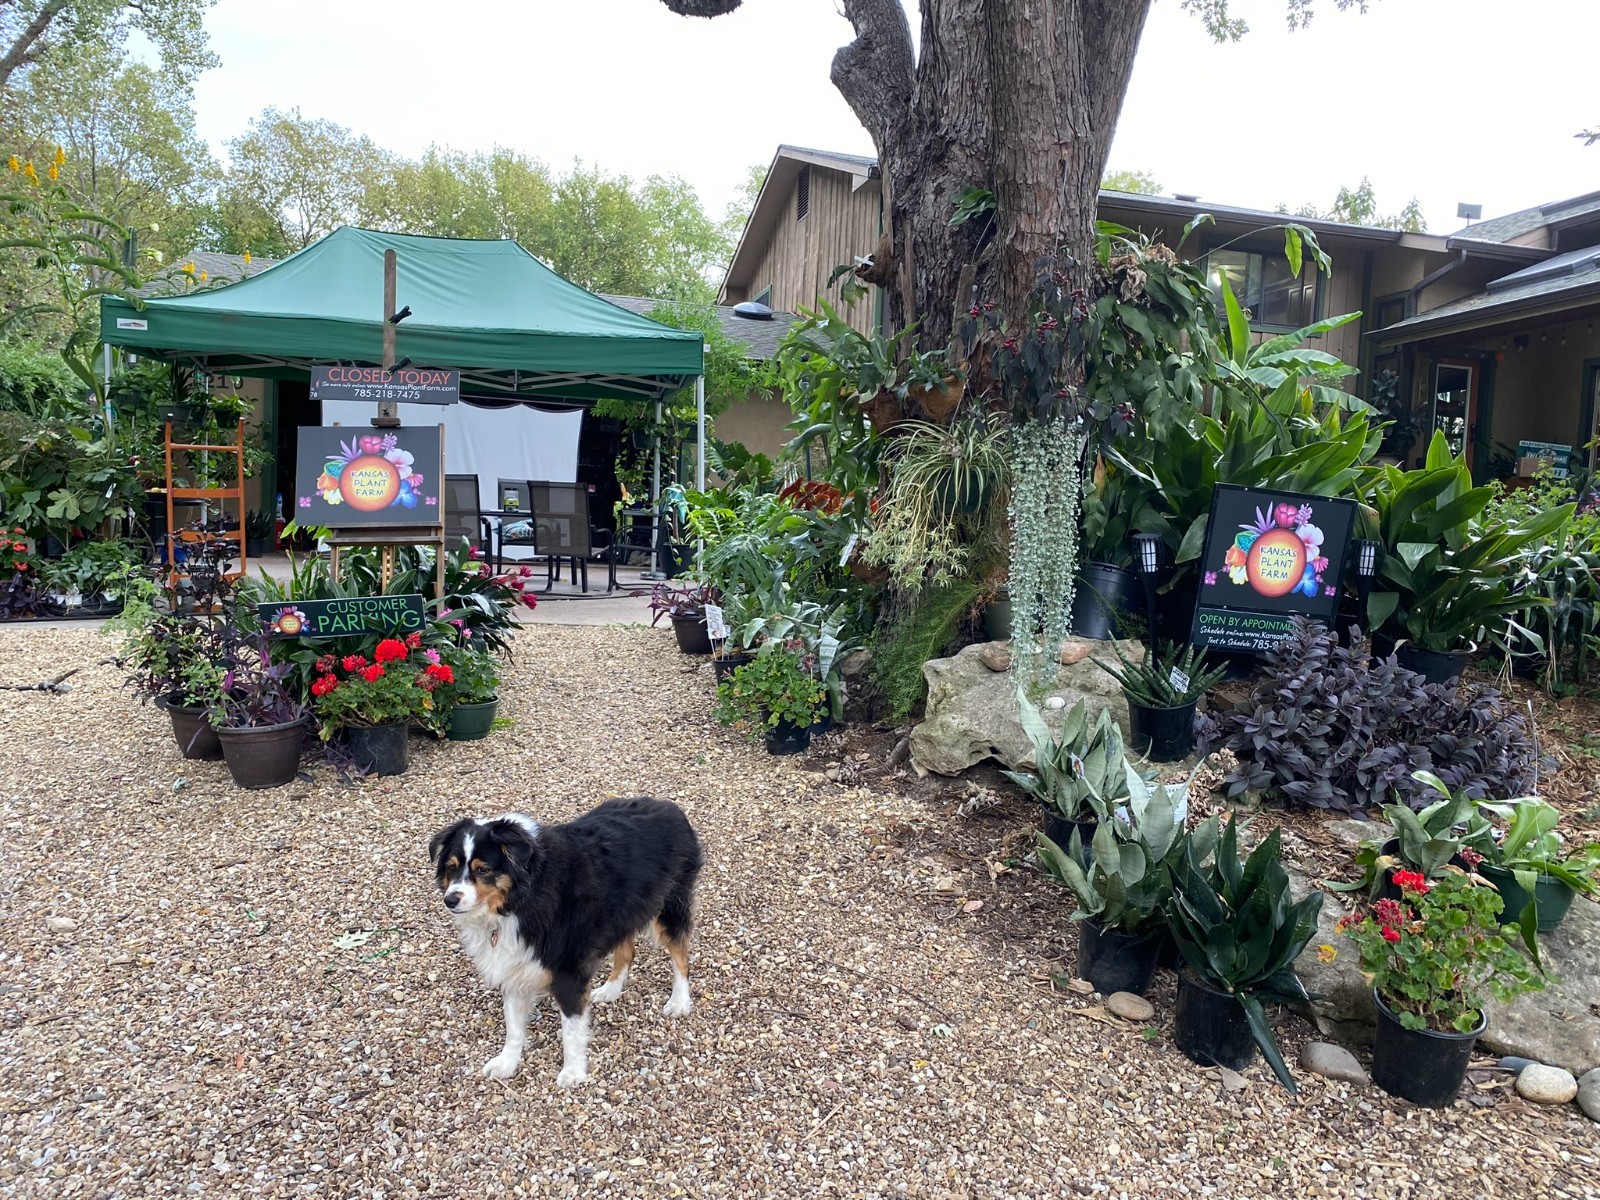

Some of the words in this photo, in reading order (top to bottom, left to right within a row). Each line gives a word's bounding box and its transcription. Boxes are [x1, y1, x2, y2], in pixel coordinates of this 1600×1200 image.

[328, 367, 393, 383] CLOSED
[398, 371, 451, 385] TODAY
[366, 383, 456, 392] www.KansasPlantFarm.com
[354, 388, 420, 399] 785-218-7475
[353, 479, 387, 487] PLANT
[1260, 546, 1298, 558] KANSAS
[1260, 557, 1294, 568] PLANT
[1260, 569, 1289, 579] FARM
[326, 598, 408, 613] CUSTOMER
[1199, 614, 1226, 625] OPEN
[1228, 617, 1240, 626] BY
[1241, 619, 1297, 631] APPOINTME
[1200, 625, 1225, 635] Schedule
[1207, 636, 1218, 644] Text
[1220, 637, 1226, 645] to
